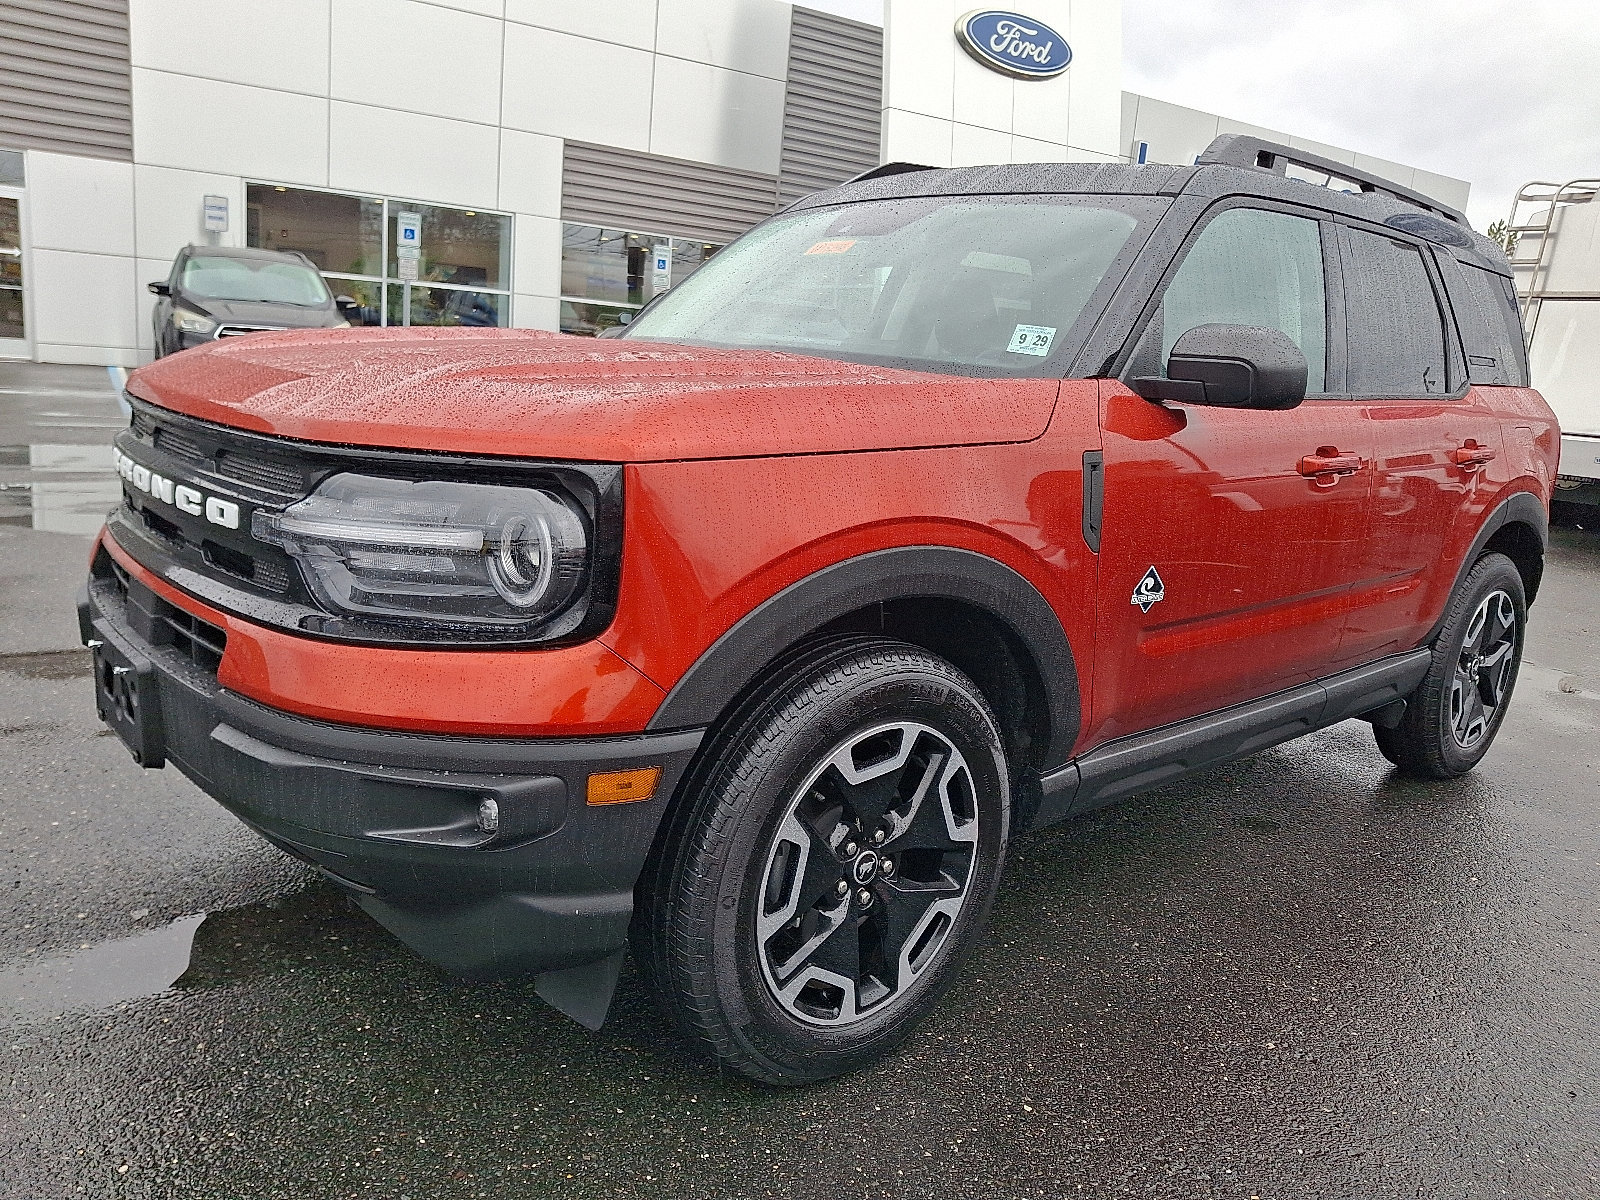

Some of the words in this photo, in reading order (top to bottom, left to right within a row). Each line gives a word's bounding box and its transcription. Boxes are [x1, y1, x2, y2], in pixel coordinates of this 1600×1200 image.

[990, 20, 1053, 65] Ford
[1018, 333, 1028, 345] 9
[1032, 335, 1049, 347] 29
